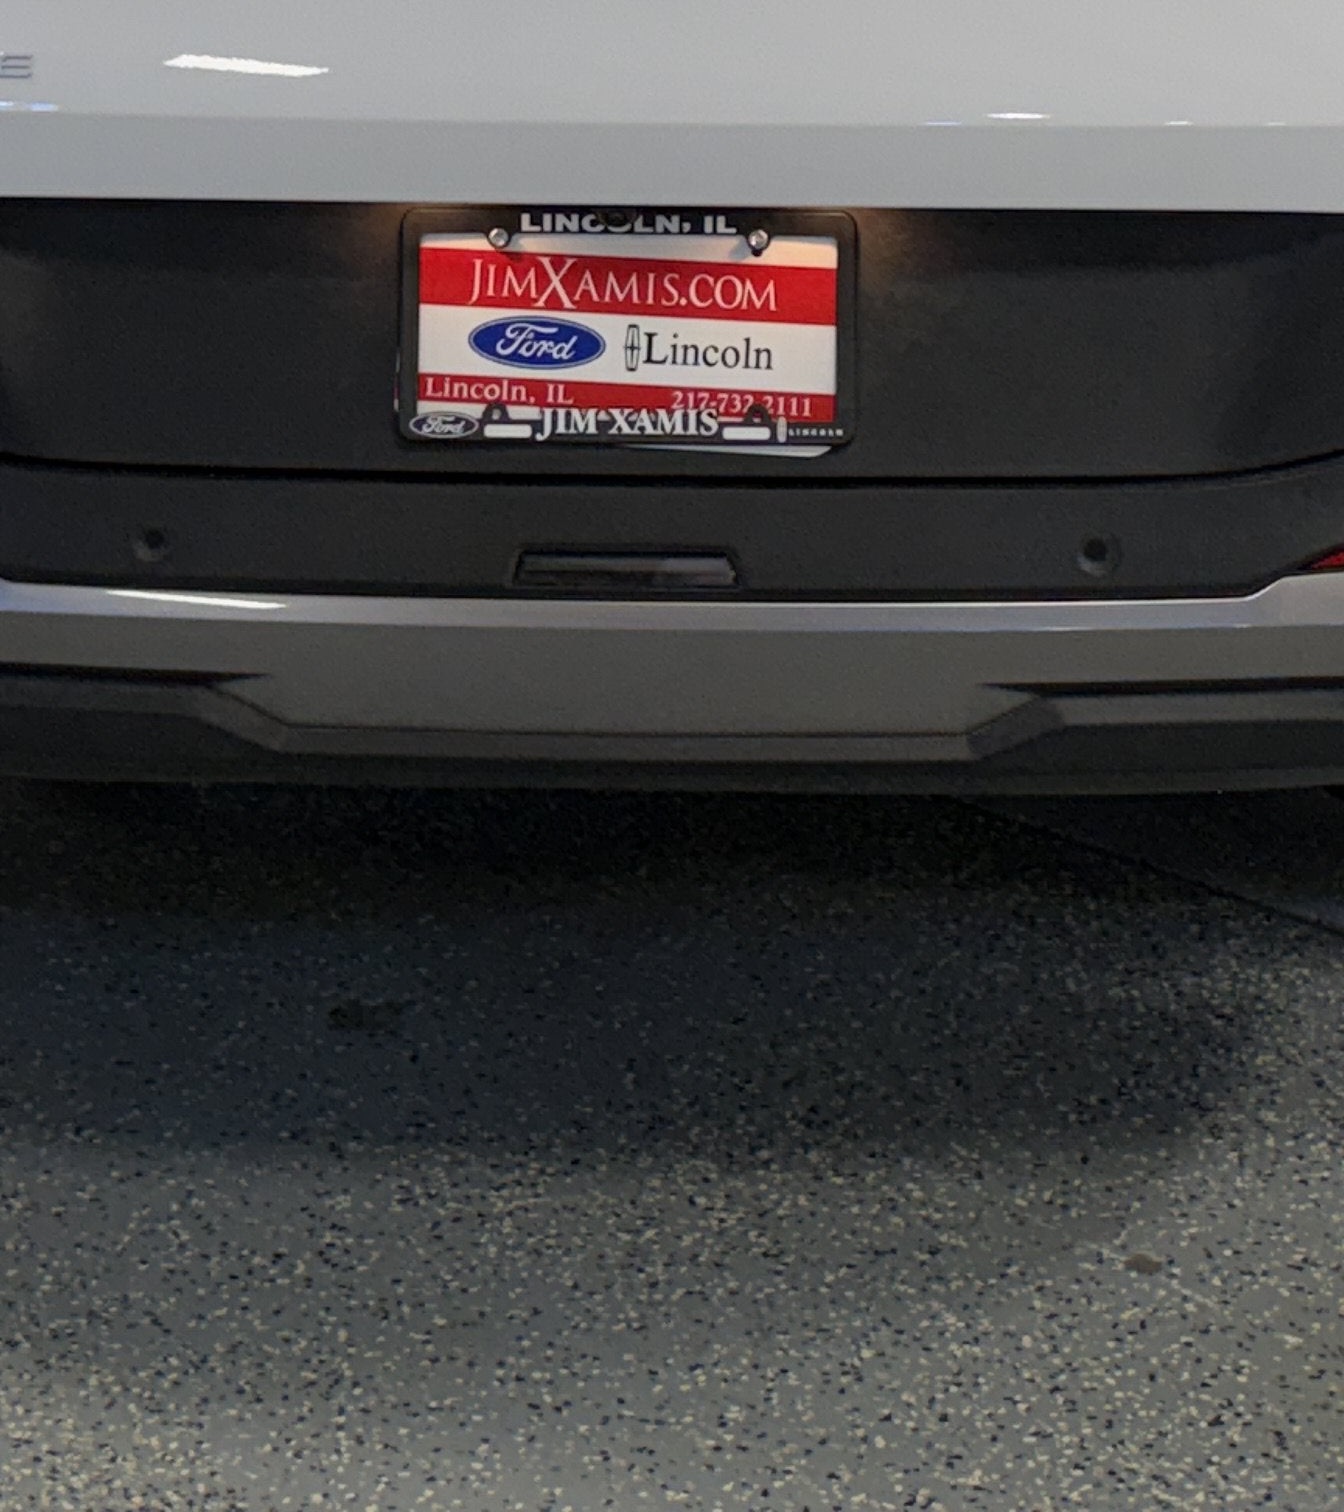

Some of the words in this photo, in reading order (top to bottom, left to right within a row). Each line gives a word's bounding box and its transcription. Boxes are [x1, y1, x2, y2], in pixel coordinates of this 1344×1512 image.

[703, 215, 738, 235] IL
[467, 255, 778, 313] JIMXAMIS.COM
[496, 322, 579, 361] Ford
[642, 331, 774, 371] Lincoln
[546, 383, 574, 404] IL
[536, 406, 598, 442] JIM
[605, 407, 720, 438] XAMIS
